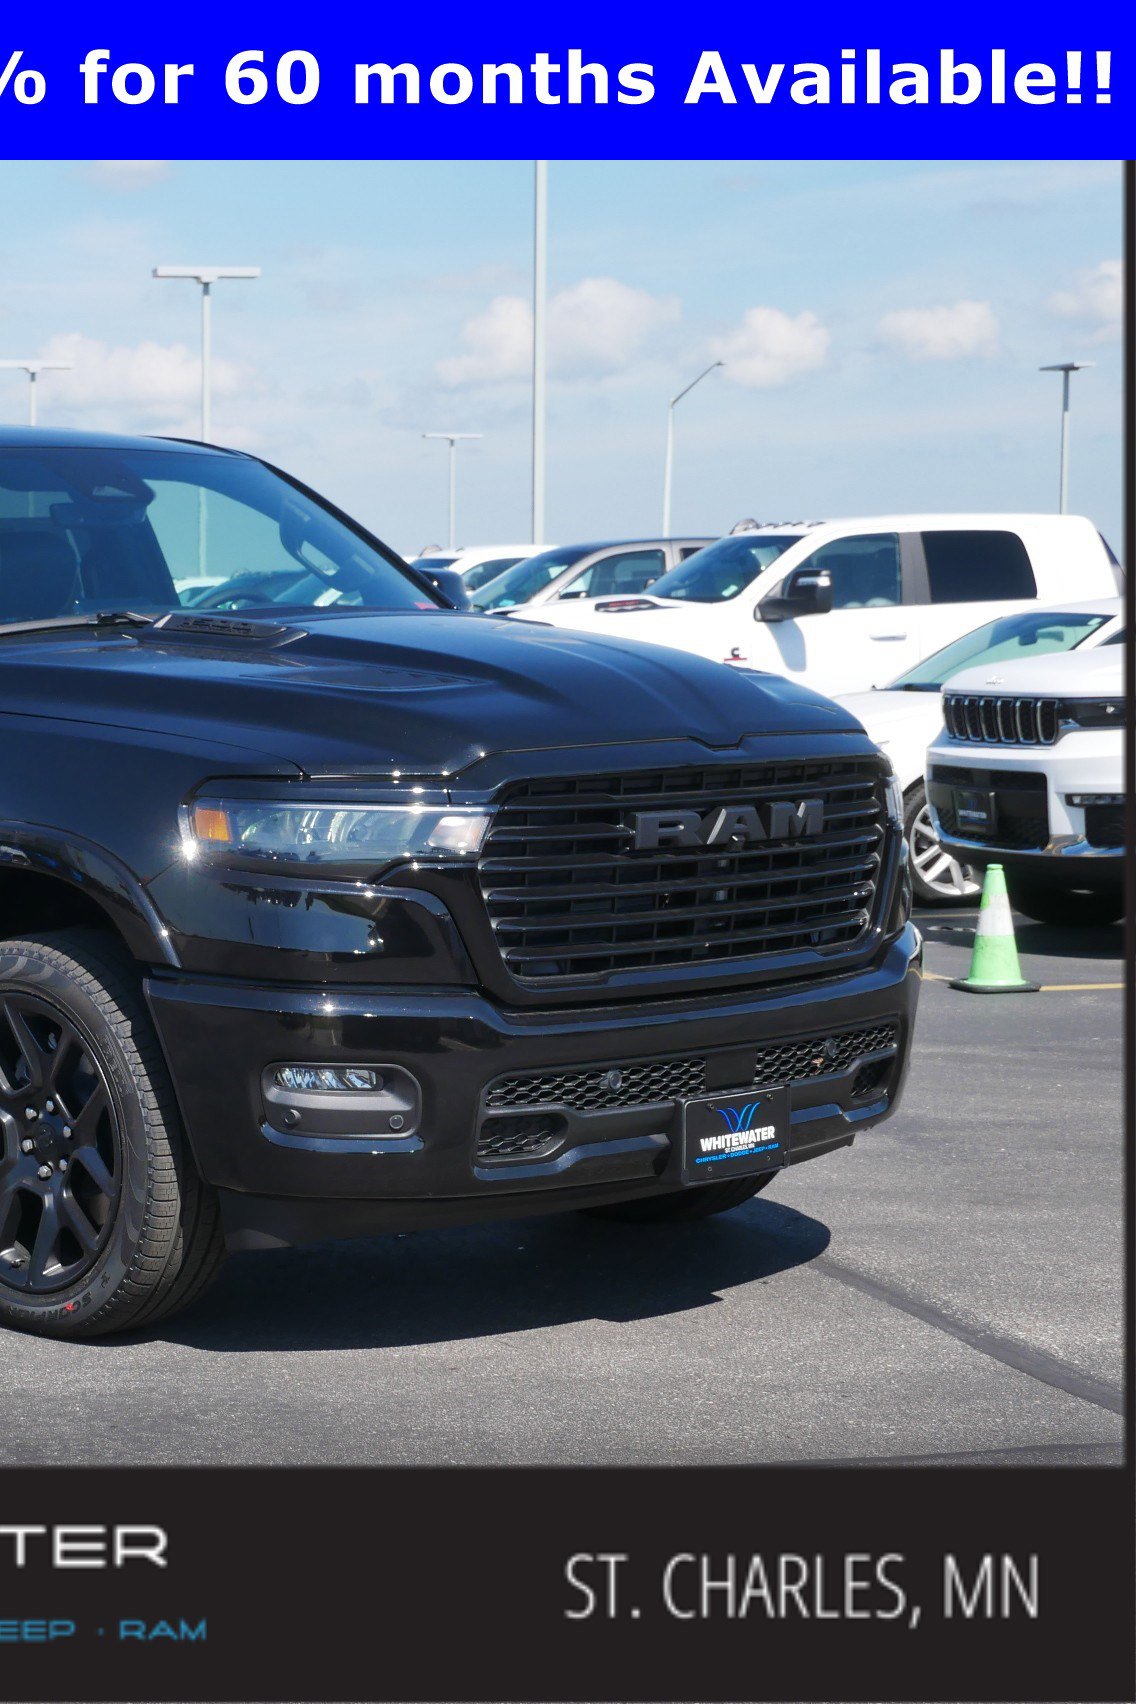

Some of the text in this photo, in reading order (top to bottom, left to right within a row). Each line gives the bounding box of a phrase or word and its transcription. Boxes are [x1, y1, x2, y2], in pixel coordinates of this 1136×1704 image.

[629, 799, 824, 850] RAM
[700, 1125, 775, 1152] WHITEWATER
[695, 1153, 727, 1164] CHRYSLER
[730, 1149, 750, 1158] DODGE
[752, 1146, 766, 1154] JEEP
